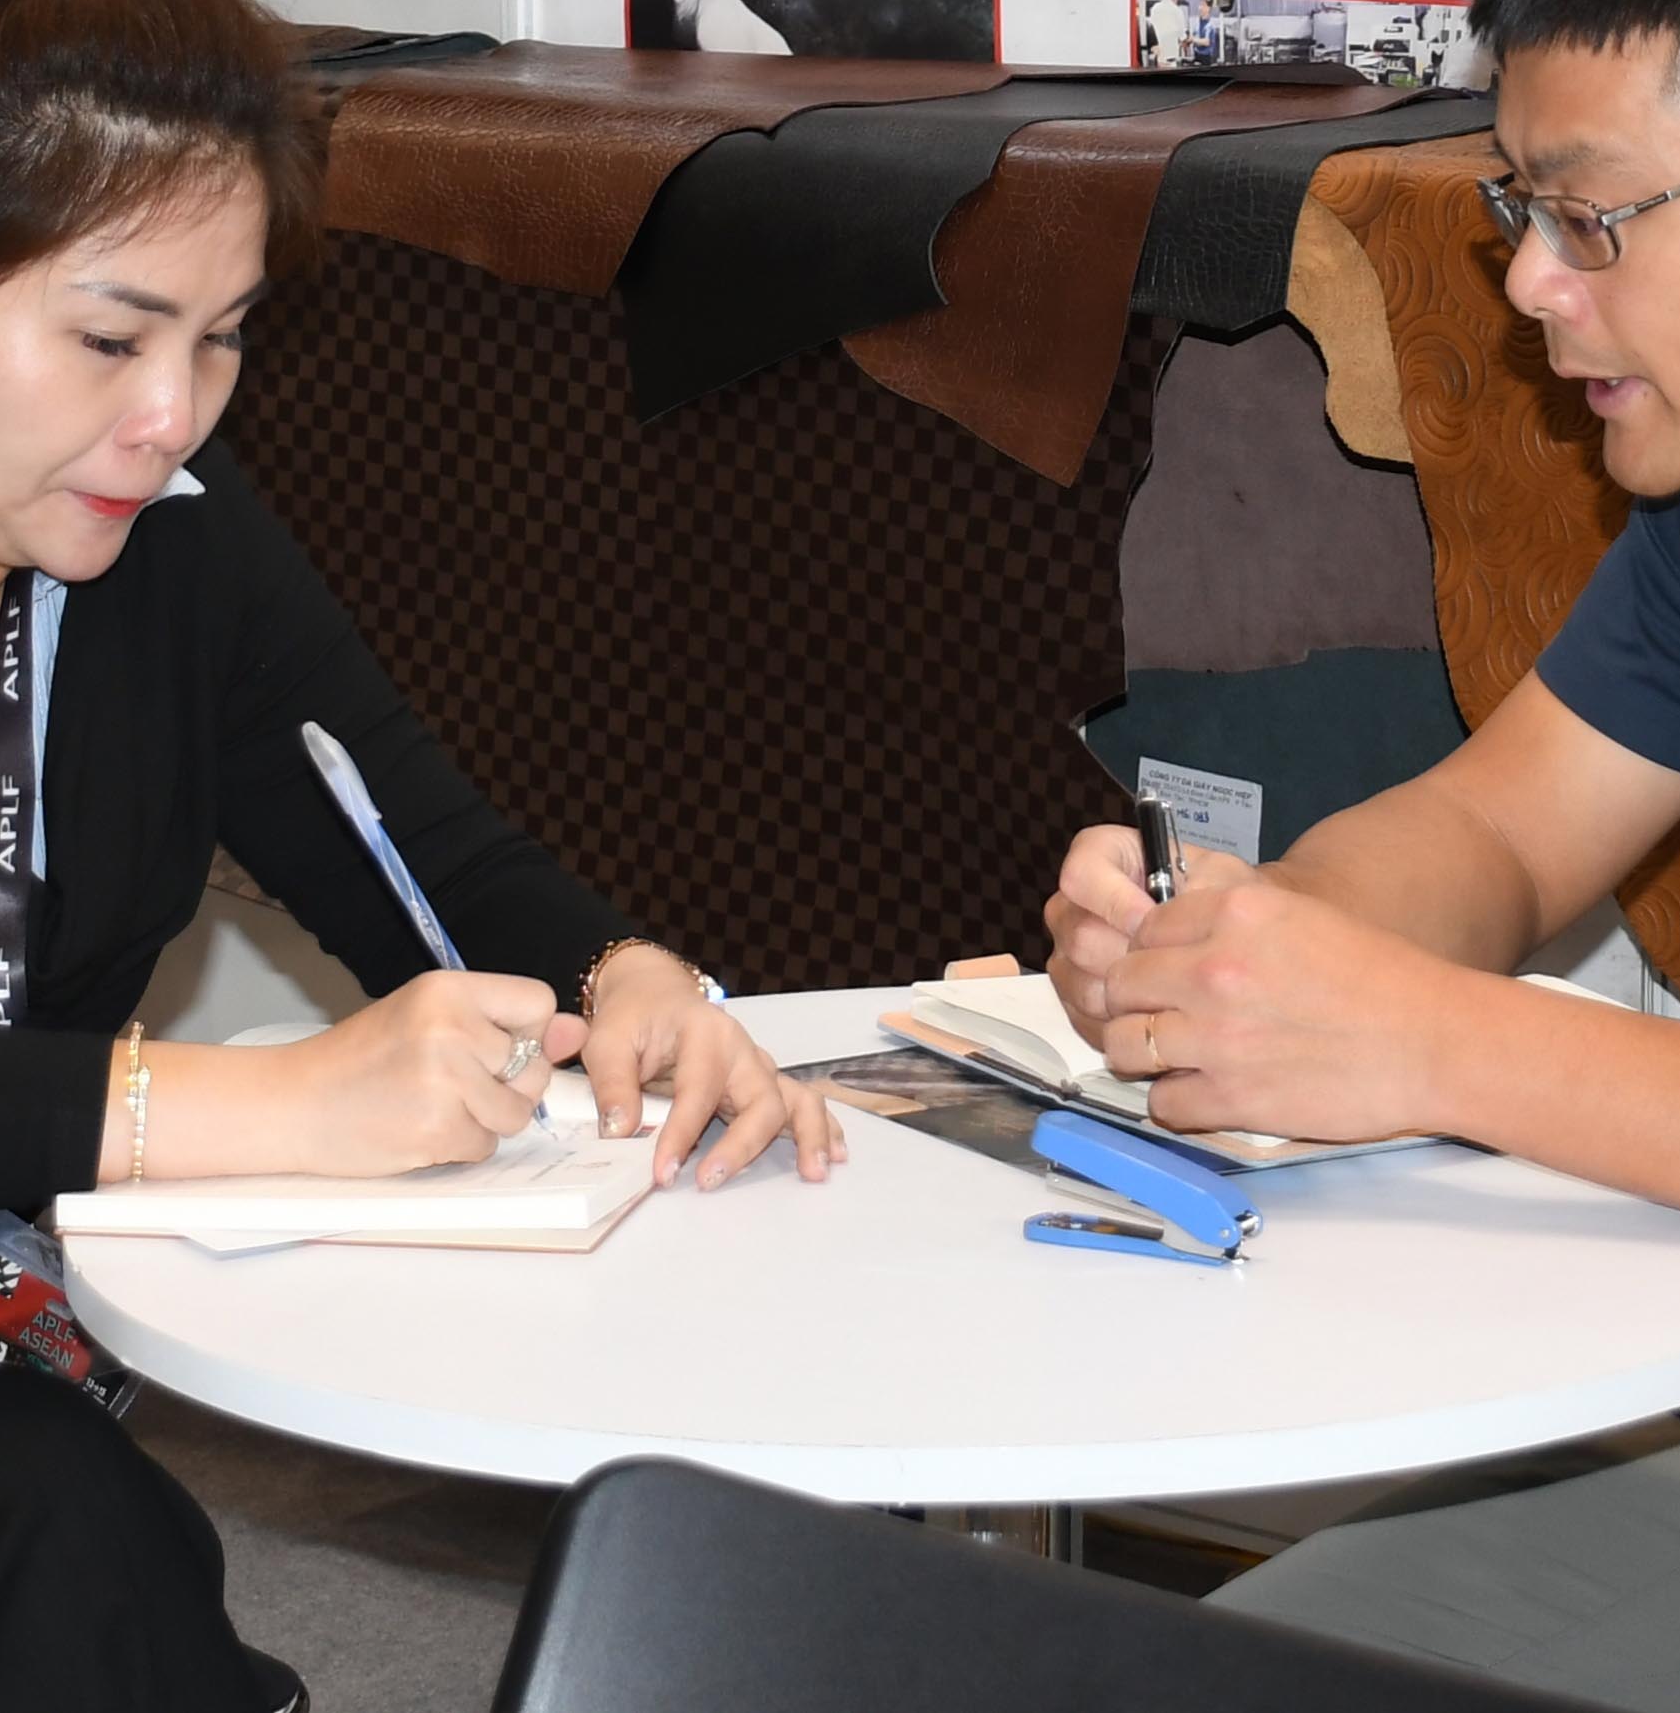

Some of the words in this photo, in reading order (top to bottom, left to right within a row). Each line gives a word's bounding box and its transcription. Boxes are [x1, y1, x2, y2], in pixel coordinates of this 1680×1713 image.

[2, 594, 22, 701] APLF
[32, 1310, 76, 1342] APLF
[19, 1327, 75, 1370] ASEAN
